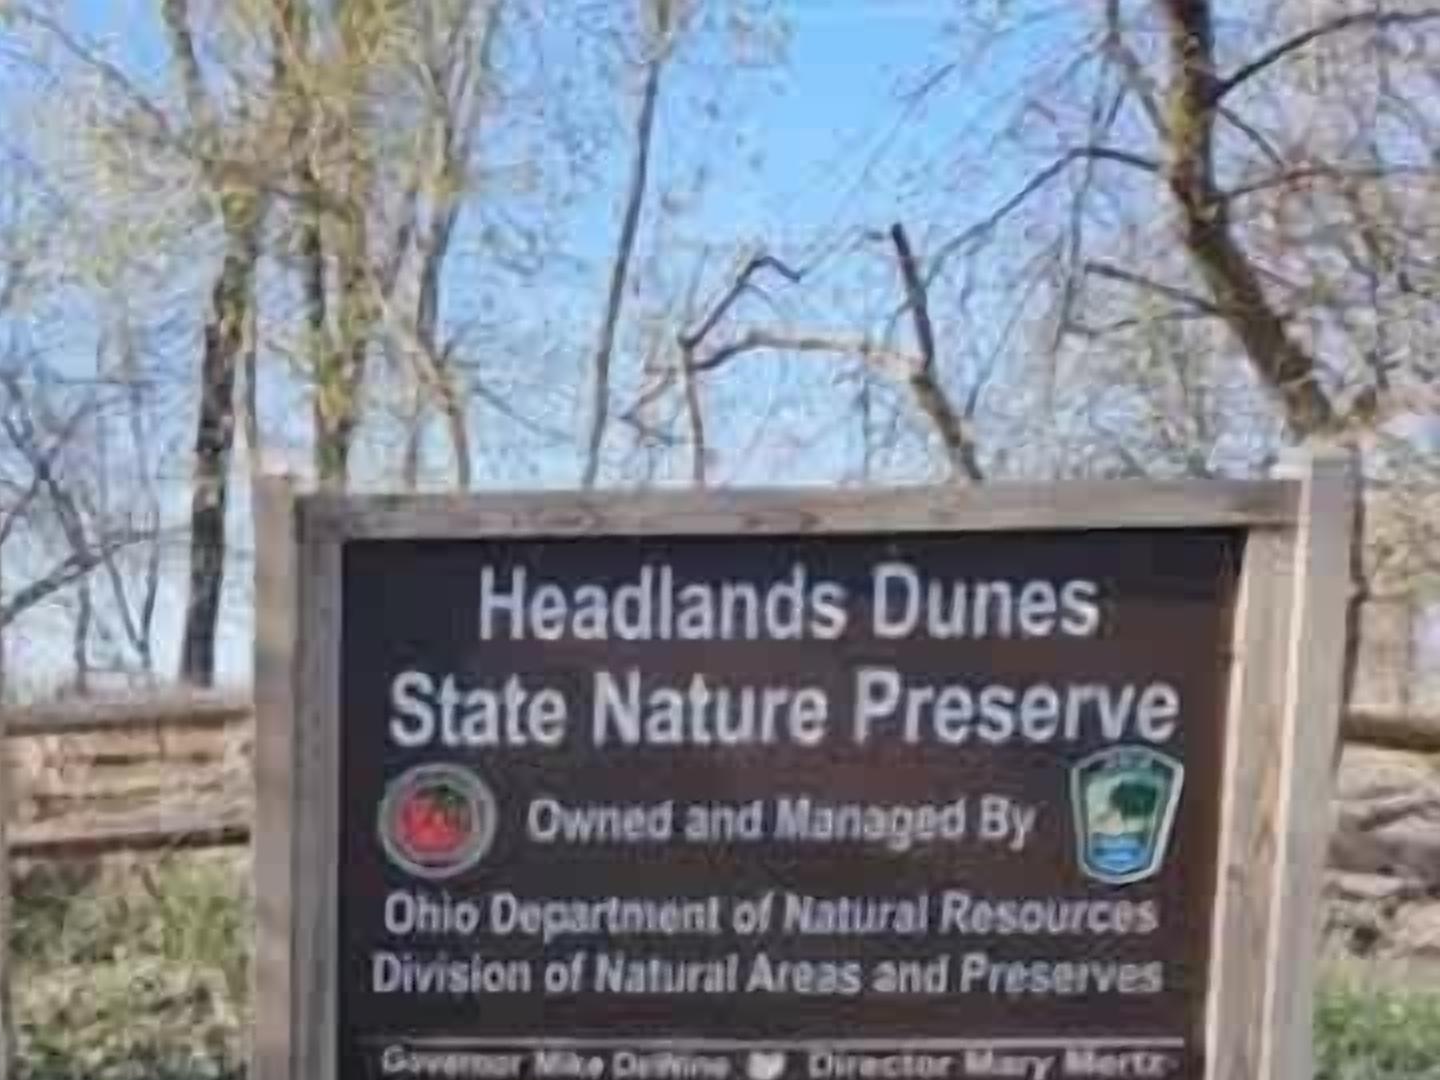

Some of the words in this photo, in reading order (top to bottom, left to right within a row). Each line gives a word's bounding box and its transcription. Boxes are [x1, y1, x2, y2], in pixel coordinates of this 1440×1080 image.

[480, 564, 847, 640] Headlands
[872, 562, 1100, 638] Dunes
[389, 671, 568, 747] State
[593, 668, 828, 746] Nature
[854, 666, 1180, 742] Preserve
[528, 798, 673, 842] Owned
[685, 800, 763, 841] and
[774, 795, 966, 852] Managed
[979, 794, 1037, 851] By
[384, 891, 480, 934] Ohio
[491, 892, 719, 943] Department
[733, 890, 774, 934] of
[782, 892, 929, 934] Natural
[940, 890, 1160, 934] Resources
[372, 952, 532, 993] Division
[545, 952, 587, 993] of
[594, 953, 739, 993] Natural
[745, 953, 862, 993] Areas
[873, 952, 951, 993] and
[960, 952, 1164, 993] Preserves
[381, 1045, 525, 1078] Governor
[534, 1048, 605, 1080] Mike
[612, 1050, 733, 1080] DeWine
[808, 1050, 953, 1080] Director
[1064, 1048, 1174, 1080] Mertz
